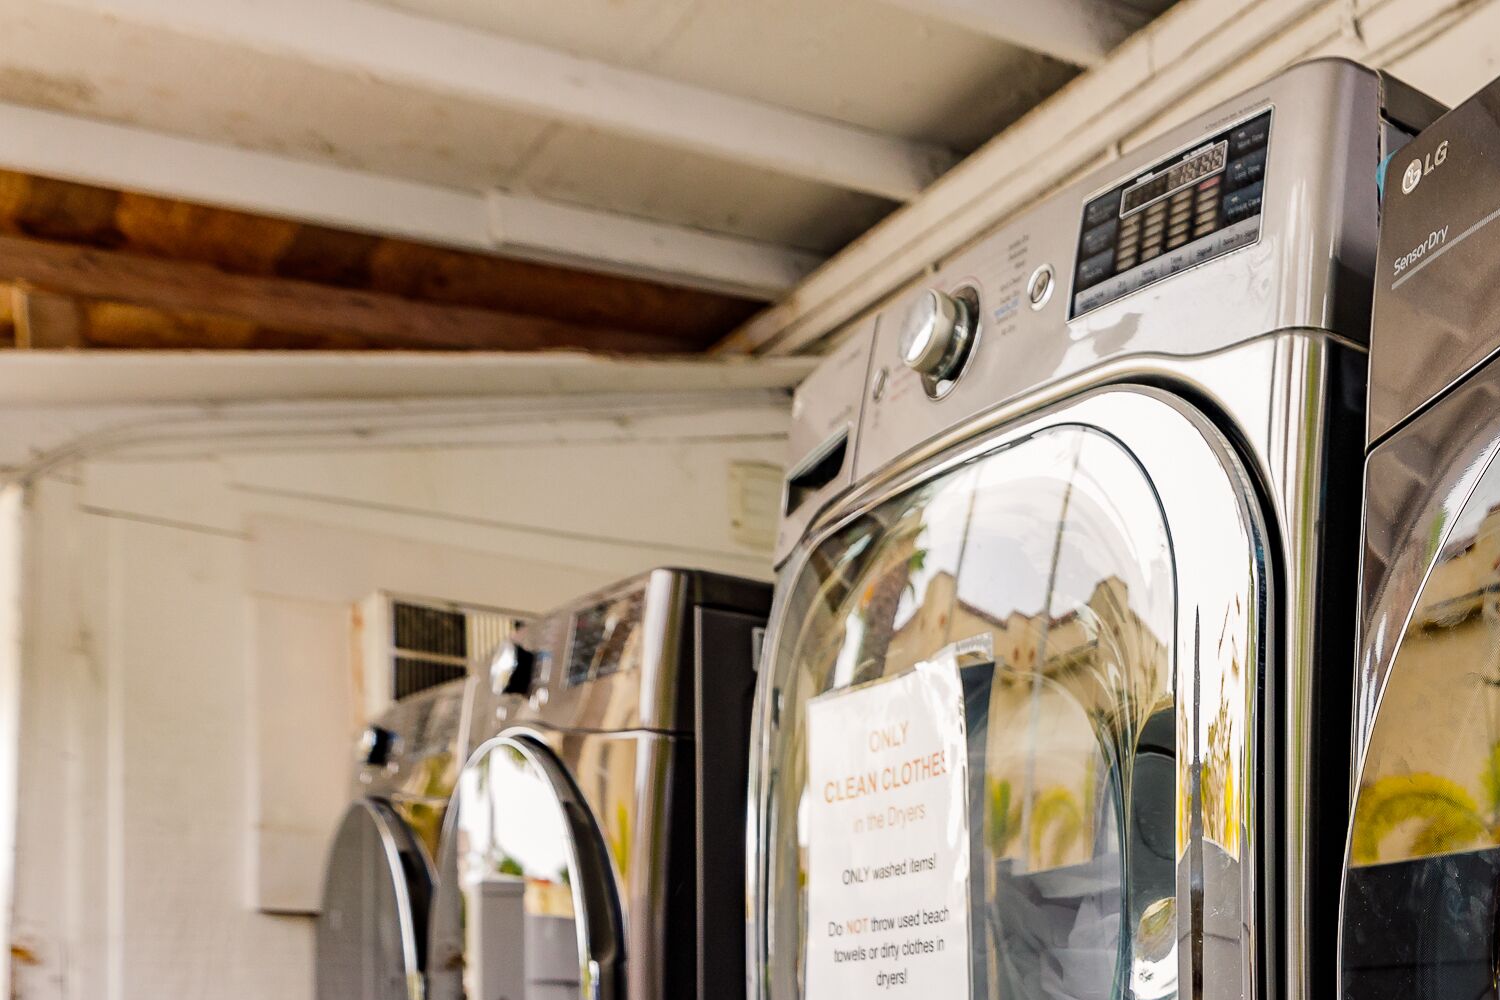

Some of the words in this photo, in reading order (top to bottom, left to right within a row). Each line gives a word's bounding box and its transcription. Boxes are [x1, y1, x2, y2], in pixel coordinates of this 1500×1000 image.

[1423, 140, 1449, 176] LG
[869, 720, 909, 752] ONLY
[824, 771, 877, 803] CLEAN
[854, 818, 863, 832] in
[867, 811, 884, 830] the
[888, 804, 925, 828] Dryers
[842, 867, 869, 885] ONLY
[872, 861, 906, 880] washed
[909, 853, 936, 873] items!
[828, 921, 843, 936] Do
[846, 918, 868, 934] NOT
[871, 915, 894, 932] throw
[898, 911, 920, 928] used
[922, 906, 949, 924] beach
[834, 946, 866, 963] towels
[869, 948, 879, 960] or
[881, 942, 899, 961] dirty
[903, 938, 934, 956] clothes
[937, 937, 945, 951] in
[876, 968, 907, 989] dryers!
